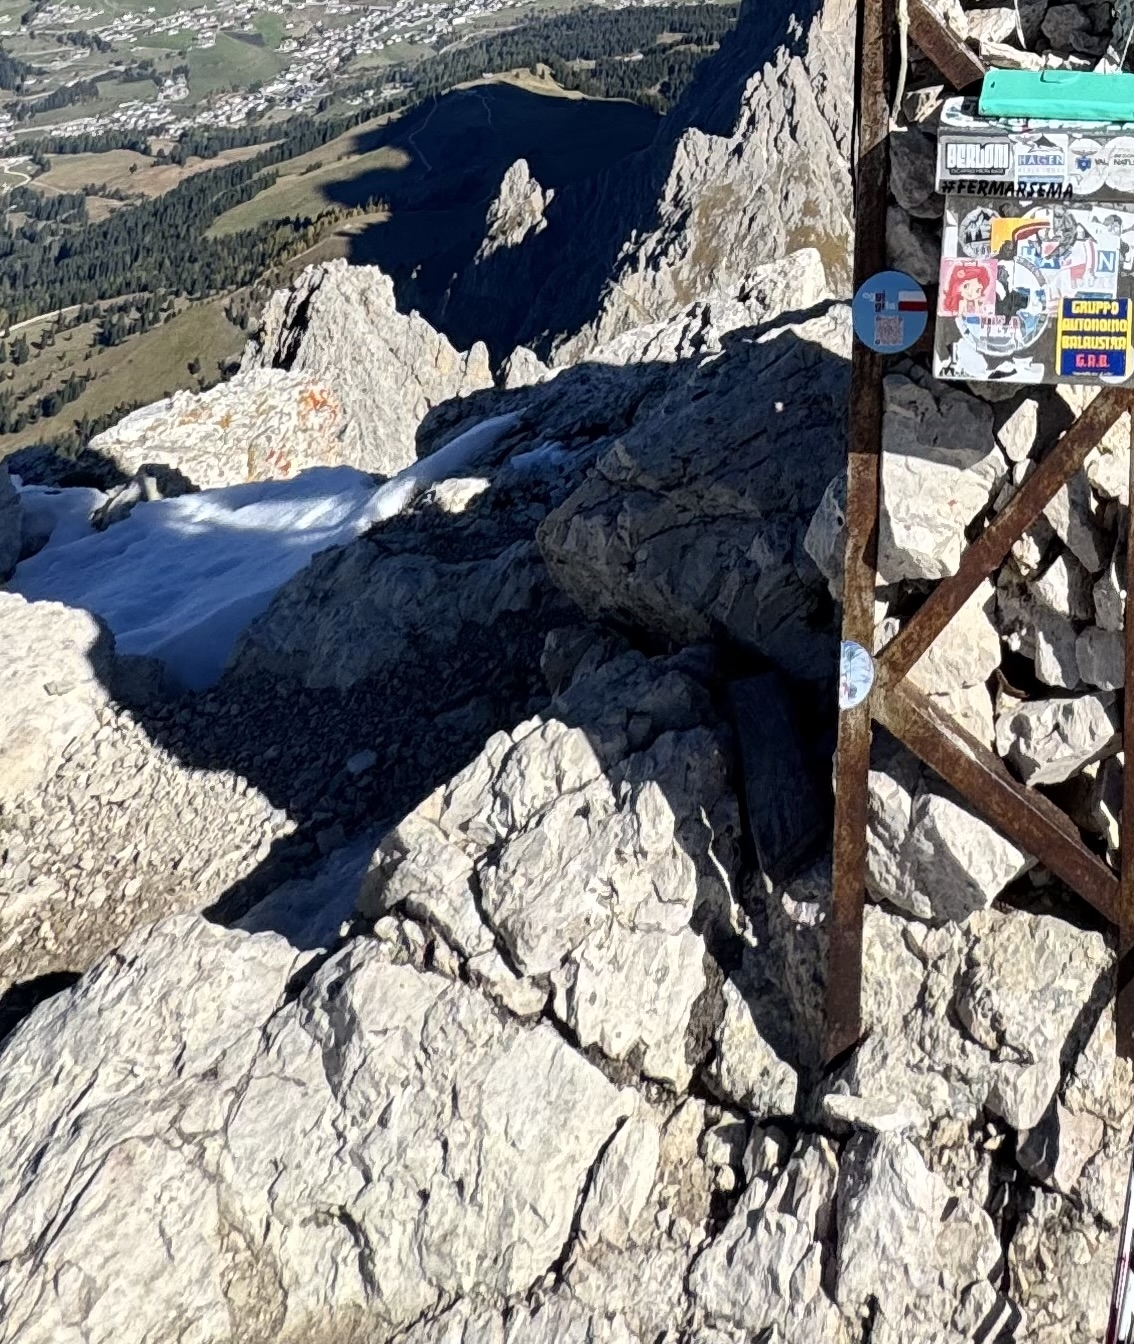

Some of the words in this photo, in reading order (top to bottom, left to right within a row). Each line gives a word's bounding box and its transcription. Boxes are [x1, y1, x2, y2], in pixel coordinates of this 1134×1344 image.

[1019, 155, 1065, 165] HAGEN
[1071, 300, 1120, 316] GRUPPO
[1062, 317, 1128, 333] AUTONOMO
